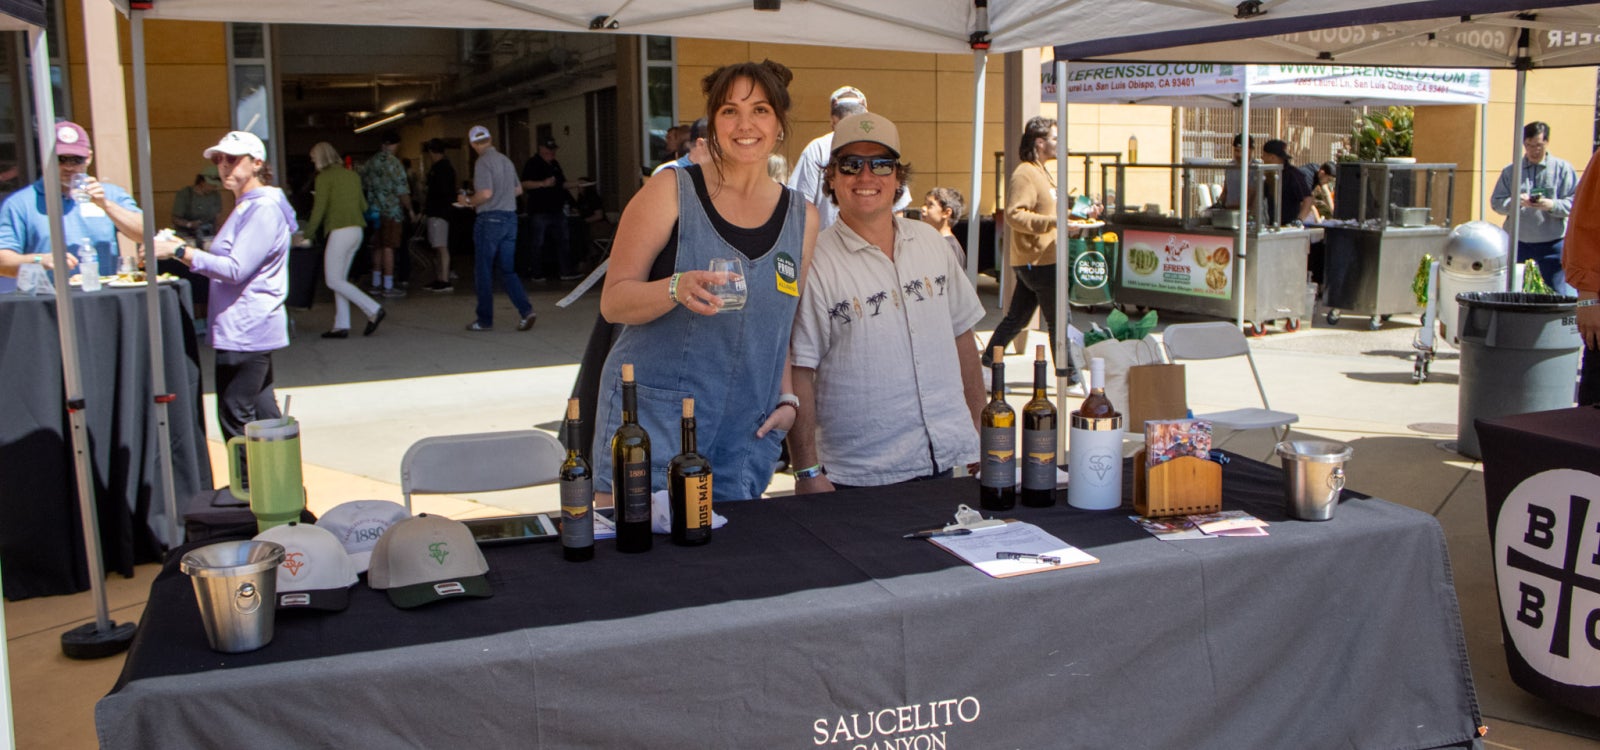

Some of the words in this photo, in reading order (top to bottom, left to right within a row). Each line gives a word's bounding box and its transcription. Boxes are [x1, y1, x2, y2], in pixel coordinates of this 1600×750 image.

[1280, 65, 1466, 83] WWW.EFRENSSLO.COM
[1096, 82, 1108, 91] San
[1111, 81, 1126, 90] Luis
[1128, 80, 1156, 91] Obispo,
[1159, 78, 1170, 88] CA
[1172, 77, 1195, 87] 93401
[1314, 79, 1338, 87] Laurel
[1354, 80, 1368, 88] San
[1371, 81, 1385, 89] Luis
[1417, 83, 1427, 91] CA
[1429, 84, 1448, 93] 93401
[777, 262, 795, 278] PROUD
[1078, 267, 1105, 275] PROUD
[629, 469, 646, 478] 1880
[699, 504, 708, 528] DOS
[355, 526, 384, 543] 1880
[1524, 503, 1556, 550] B
[1517, 581, 1546, 629] B
[813, 696, 981, 745] SAUCELITO
[852, 731, 947, 750] NYON
